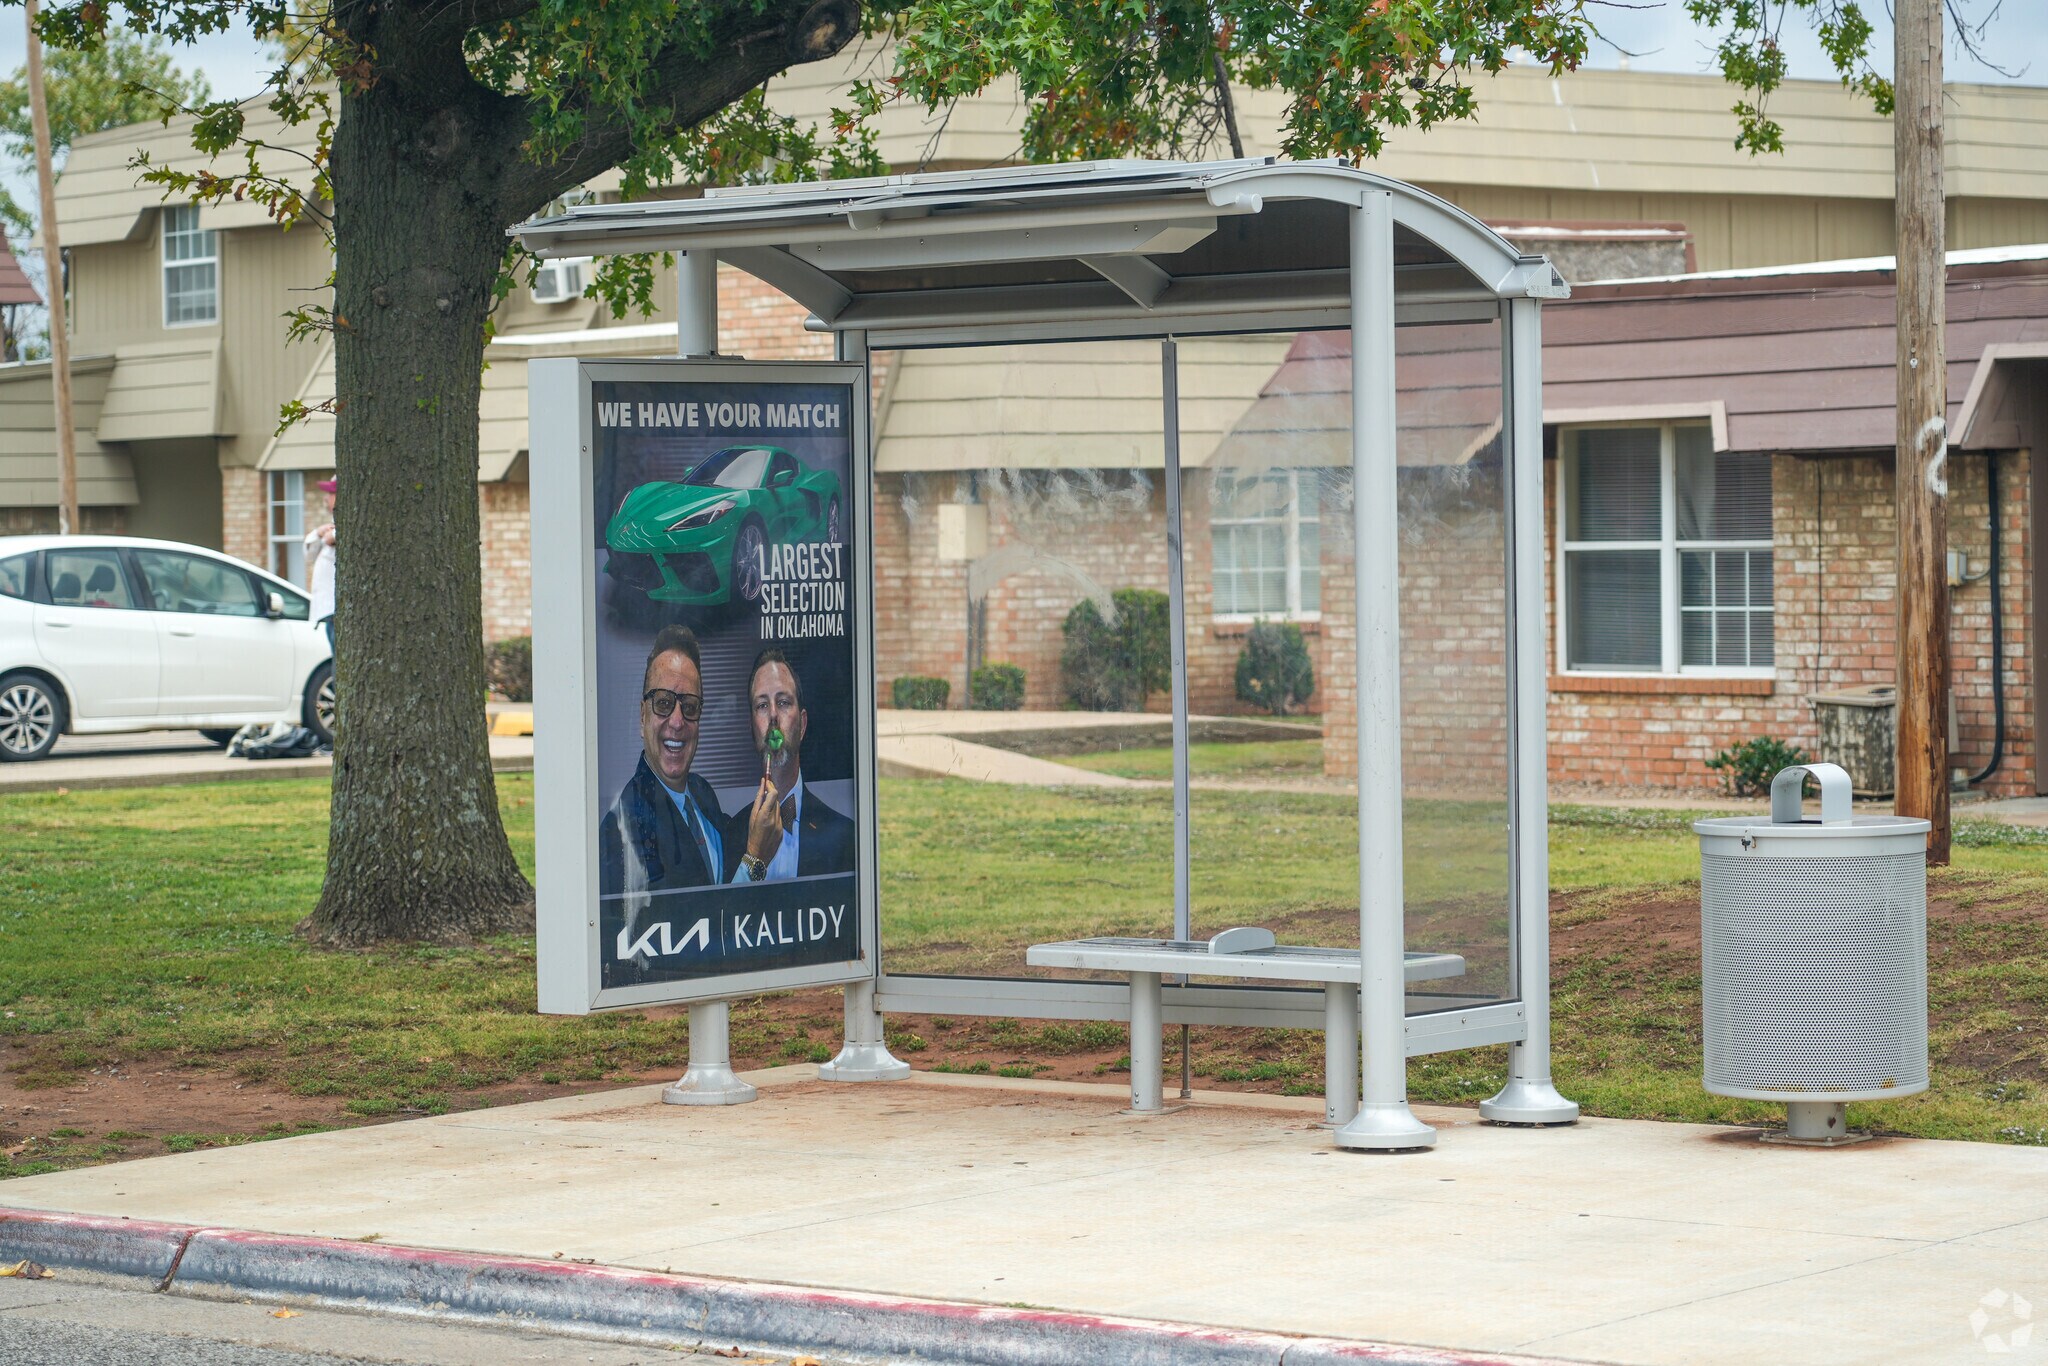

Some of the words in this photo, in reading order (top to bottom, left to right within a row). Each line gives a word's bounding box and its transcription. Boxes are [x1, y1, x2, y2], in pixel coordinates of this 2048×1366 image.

[598, 402, 632, 428] WE
[638, 402, 699, 428] HAVE
[705, 402, 761, 428] YOUR
[766, 403, 840, 428] MATCH
[758, 542, 843, 581] LARGEST
[760, 581, 845, 614] SELECTION
[760, 616, 774, 639] IN
[777, 613, 845, 639] OKLAHOMA
[616, 918, 710, 960] KIA
[734, 904, 846, 949] KALIDY
